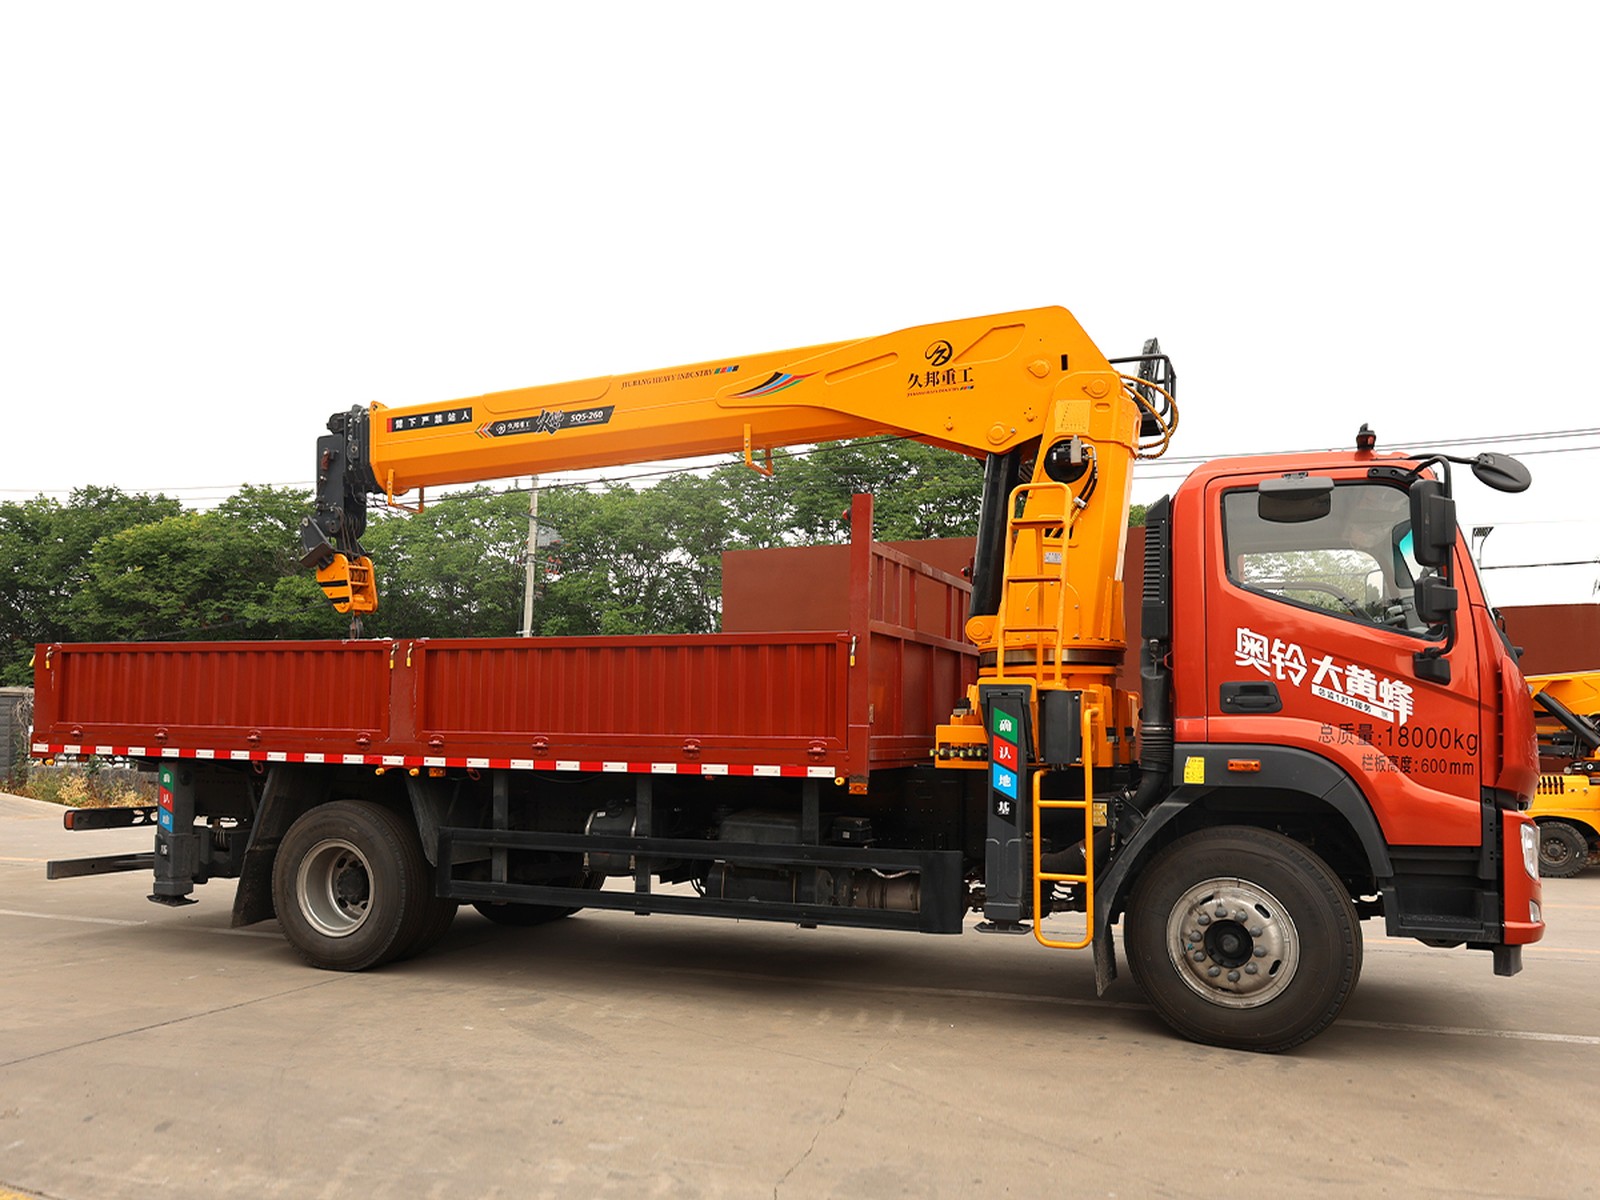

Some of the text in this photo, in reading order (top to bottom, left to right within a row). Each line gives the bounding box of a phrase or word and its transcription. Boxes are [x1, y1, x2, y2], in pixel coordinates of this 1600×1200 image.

[652, 374, 676, 384] HEAVY
[907, 367, 974, 390] 久邦重工
[570, 410, 603, 422] SQS-260
